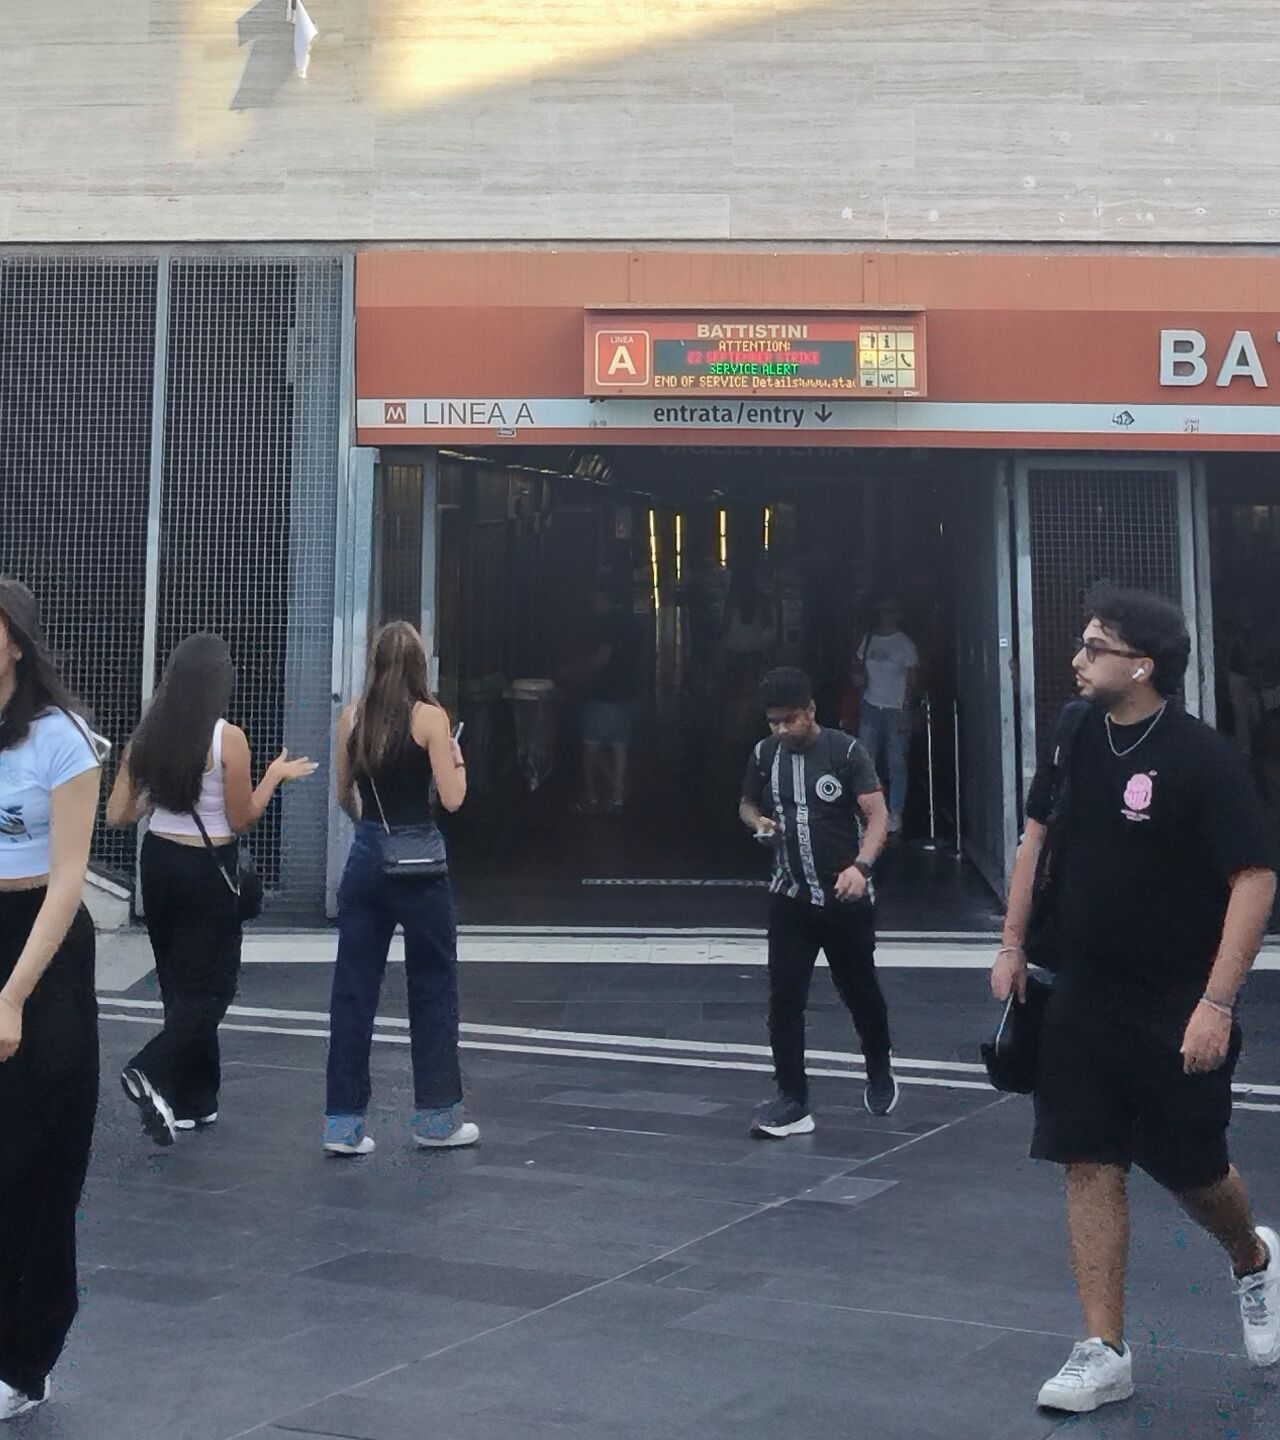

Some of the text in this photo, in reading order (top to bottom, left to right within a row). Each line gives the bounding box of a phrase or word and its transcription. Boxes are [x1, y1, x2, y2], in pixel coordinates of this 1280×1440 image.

[697, 324, 808, 339] BATTISTINI
[610, 336, 635, 344] LINEA
[719, 340, 791, 352] ATTENTION:
[608, 345, 637, 375] A
[710, 363, 799, 375] SERVICE ALERT
[655, 376, 677, 388] END
[681, 376, 696, 388] OF
[699, 376, 748, 388] SERVICE
[423, 402, 507, 425] LINEA
[515, 402, 535, 425] A
[653, 403, 804, 427] entrata/entry
